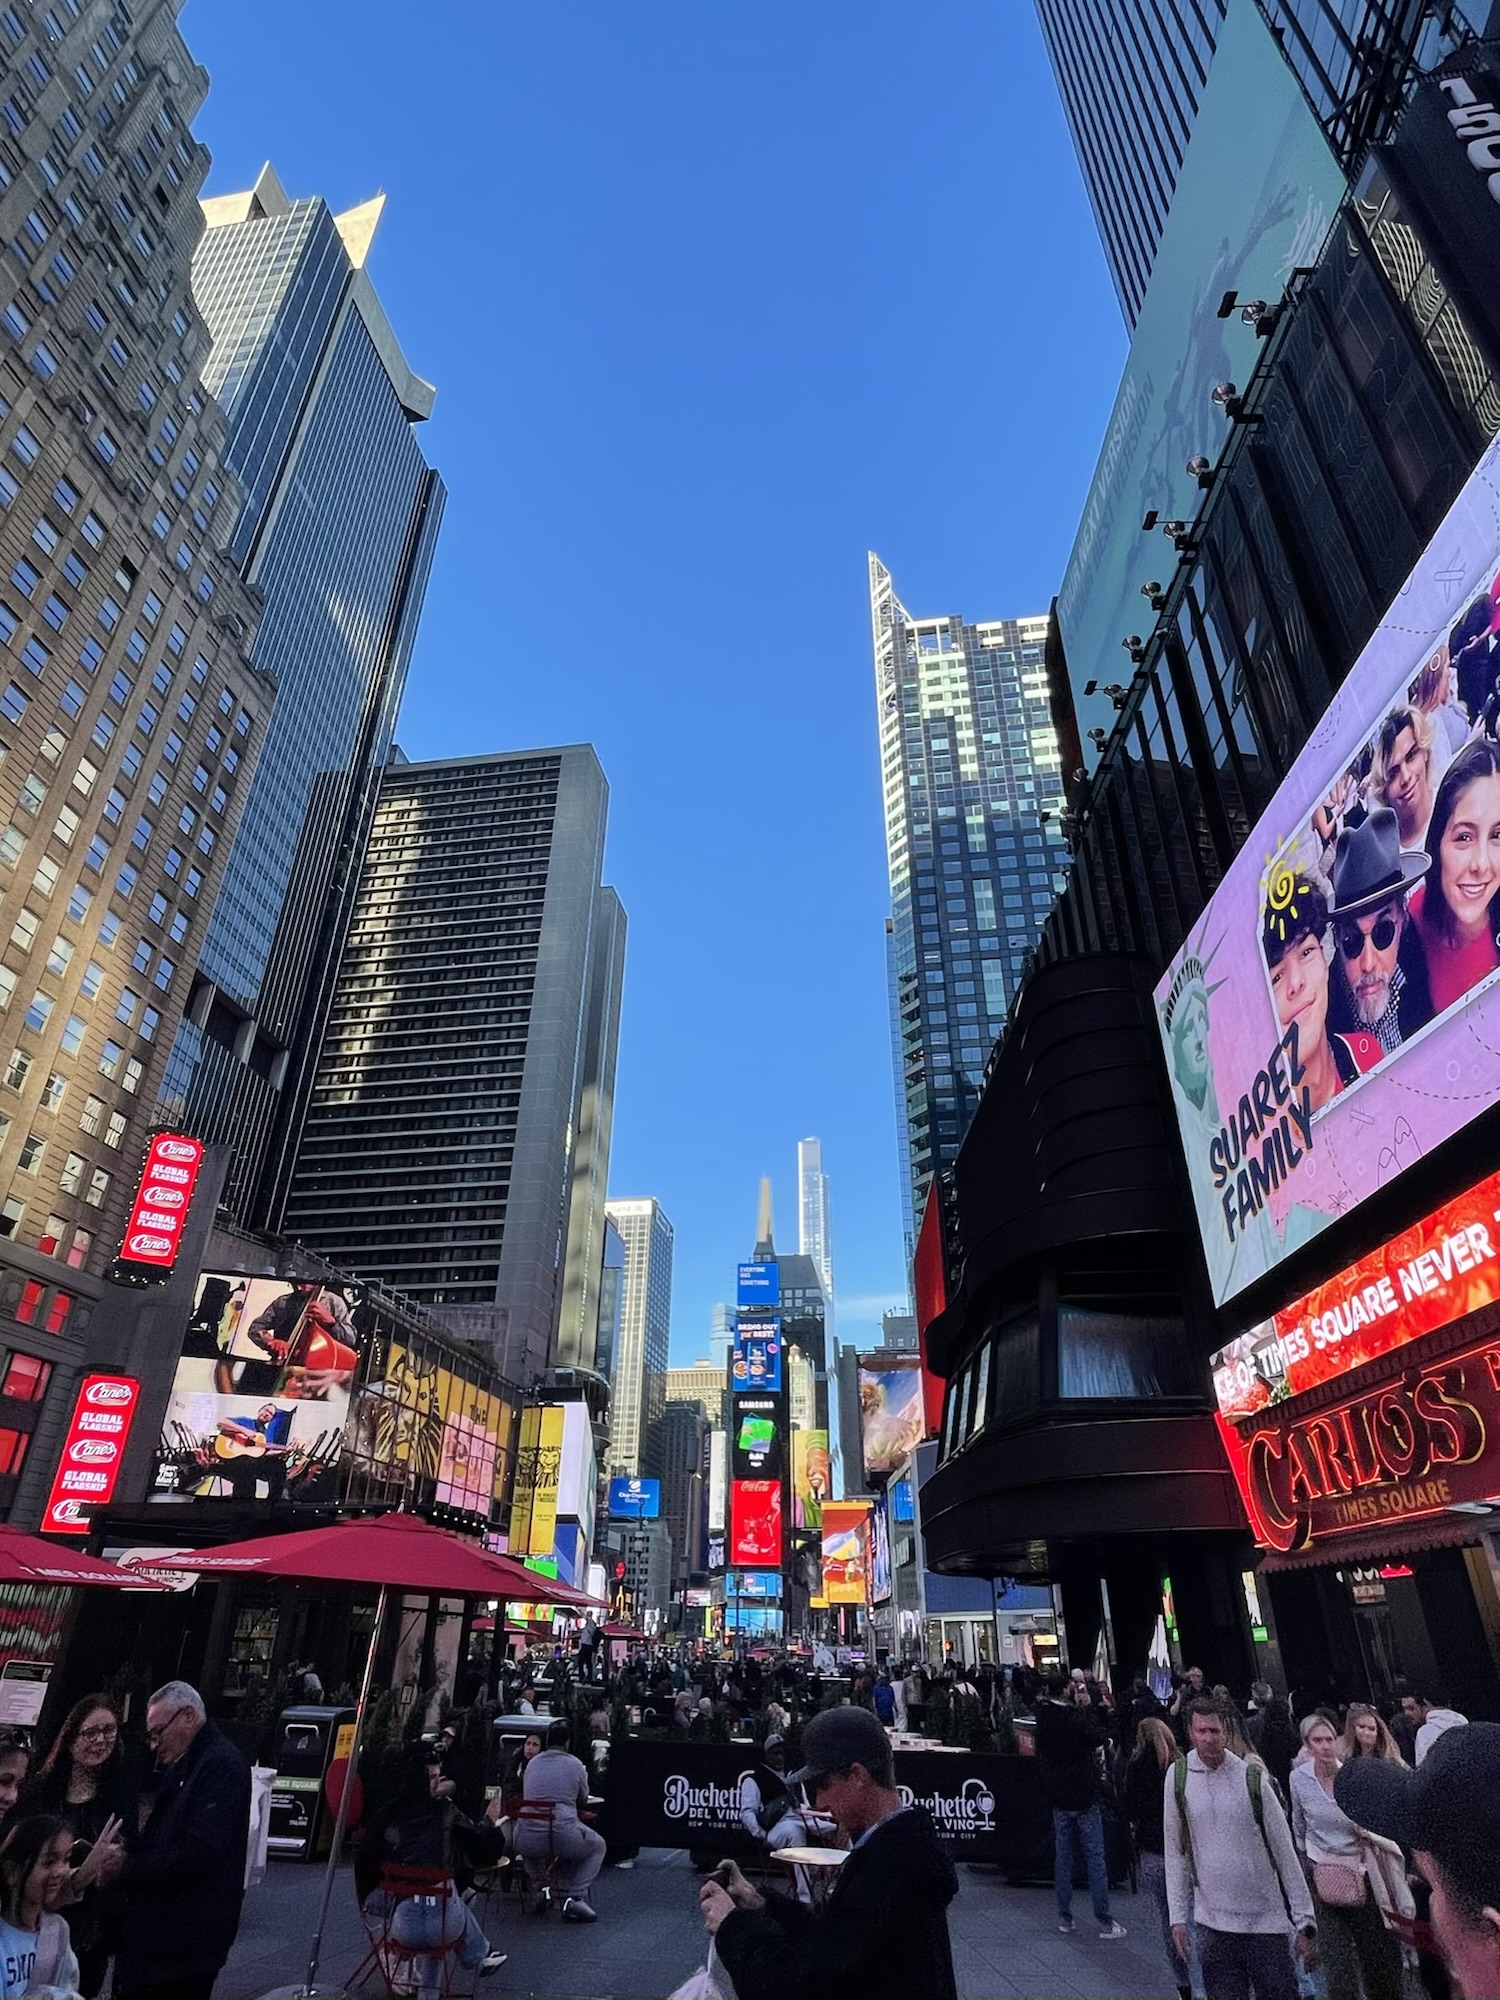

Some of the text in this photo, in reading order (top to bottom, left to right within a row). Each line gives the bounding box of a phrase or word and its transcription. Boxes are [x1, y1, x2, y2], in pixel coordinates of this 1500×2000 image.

[1112, 370, 1155, 501] VERSION
[1060, 373, 1138, 626] YOUR NEXT VERSION
[1210, 1021, 1307, 1189] SUAREZ
[152, 1164, 190, 1178] GLOBAL
[1222, 1085, 1313, 1243] FAMILY
[150, 1172, 189, 1185] FLAGSHIP
[139, 1210, 177, 1225] GLOBAL
[137, 1219, 176, 1232] FLAGSHIP
[1236, 1355, 1258, 1389] OF
[1257, 1326, 1310, 1378] TIMES
[1310, 1276, 1399, 1350] SQUARE
[1398, 1222, 1496, 1303] NEVER
[739, 1400, 775, 1409] SAMSUNG
[80, 1412, 124, 1426] GLOBAL
[78, 1422, 123, 1433] FLAGSHIP
[64, 1470, 108, 1484] GLOBAL
[61, 1480, 107, 1492] FLAGSHIP
[1335, 1479, 1452, 1525] TIMES SQUARE
[664, 1774, 741, 1818] Buchett
[688, 1807, 741, 1821] DEL VIN
[708, 1821, 727, 1829] YORK
[943, 1818, 975, 1831] VINO
[959, 1832, 977, 1840] CITY
